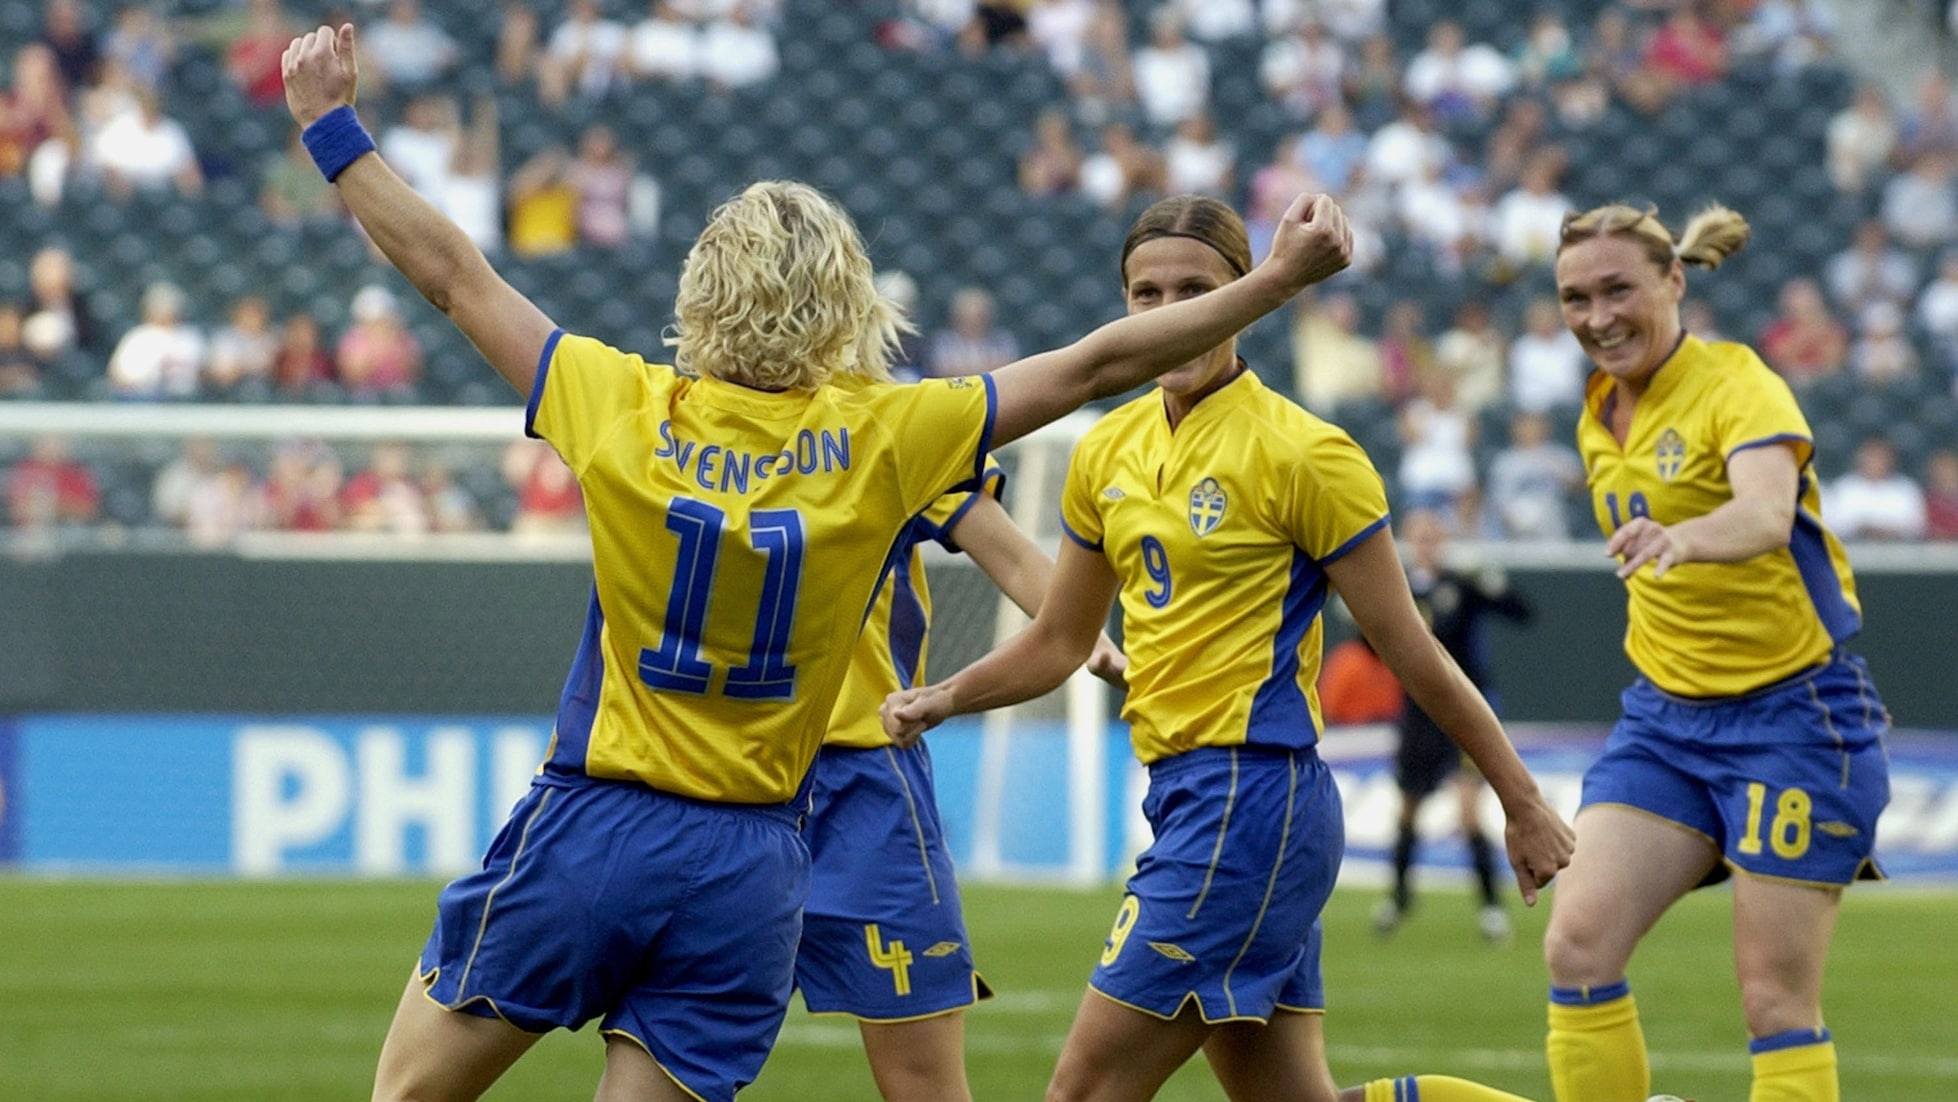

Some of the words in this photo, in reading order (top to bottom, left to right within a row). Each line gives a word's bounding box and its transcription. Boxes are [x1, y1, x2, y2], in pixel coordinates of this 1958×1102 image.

[638, 496, 808, 700] 11
[1140, 534, 1173, 609] 9
[1738, 782, 1812, 859] 18
[864, 923, 914, 996] 4
[1100, 895, 1140, 967] 9
